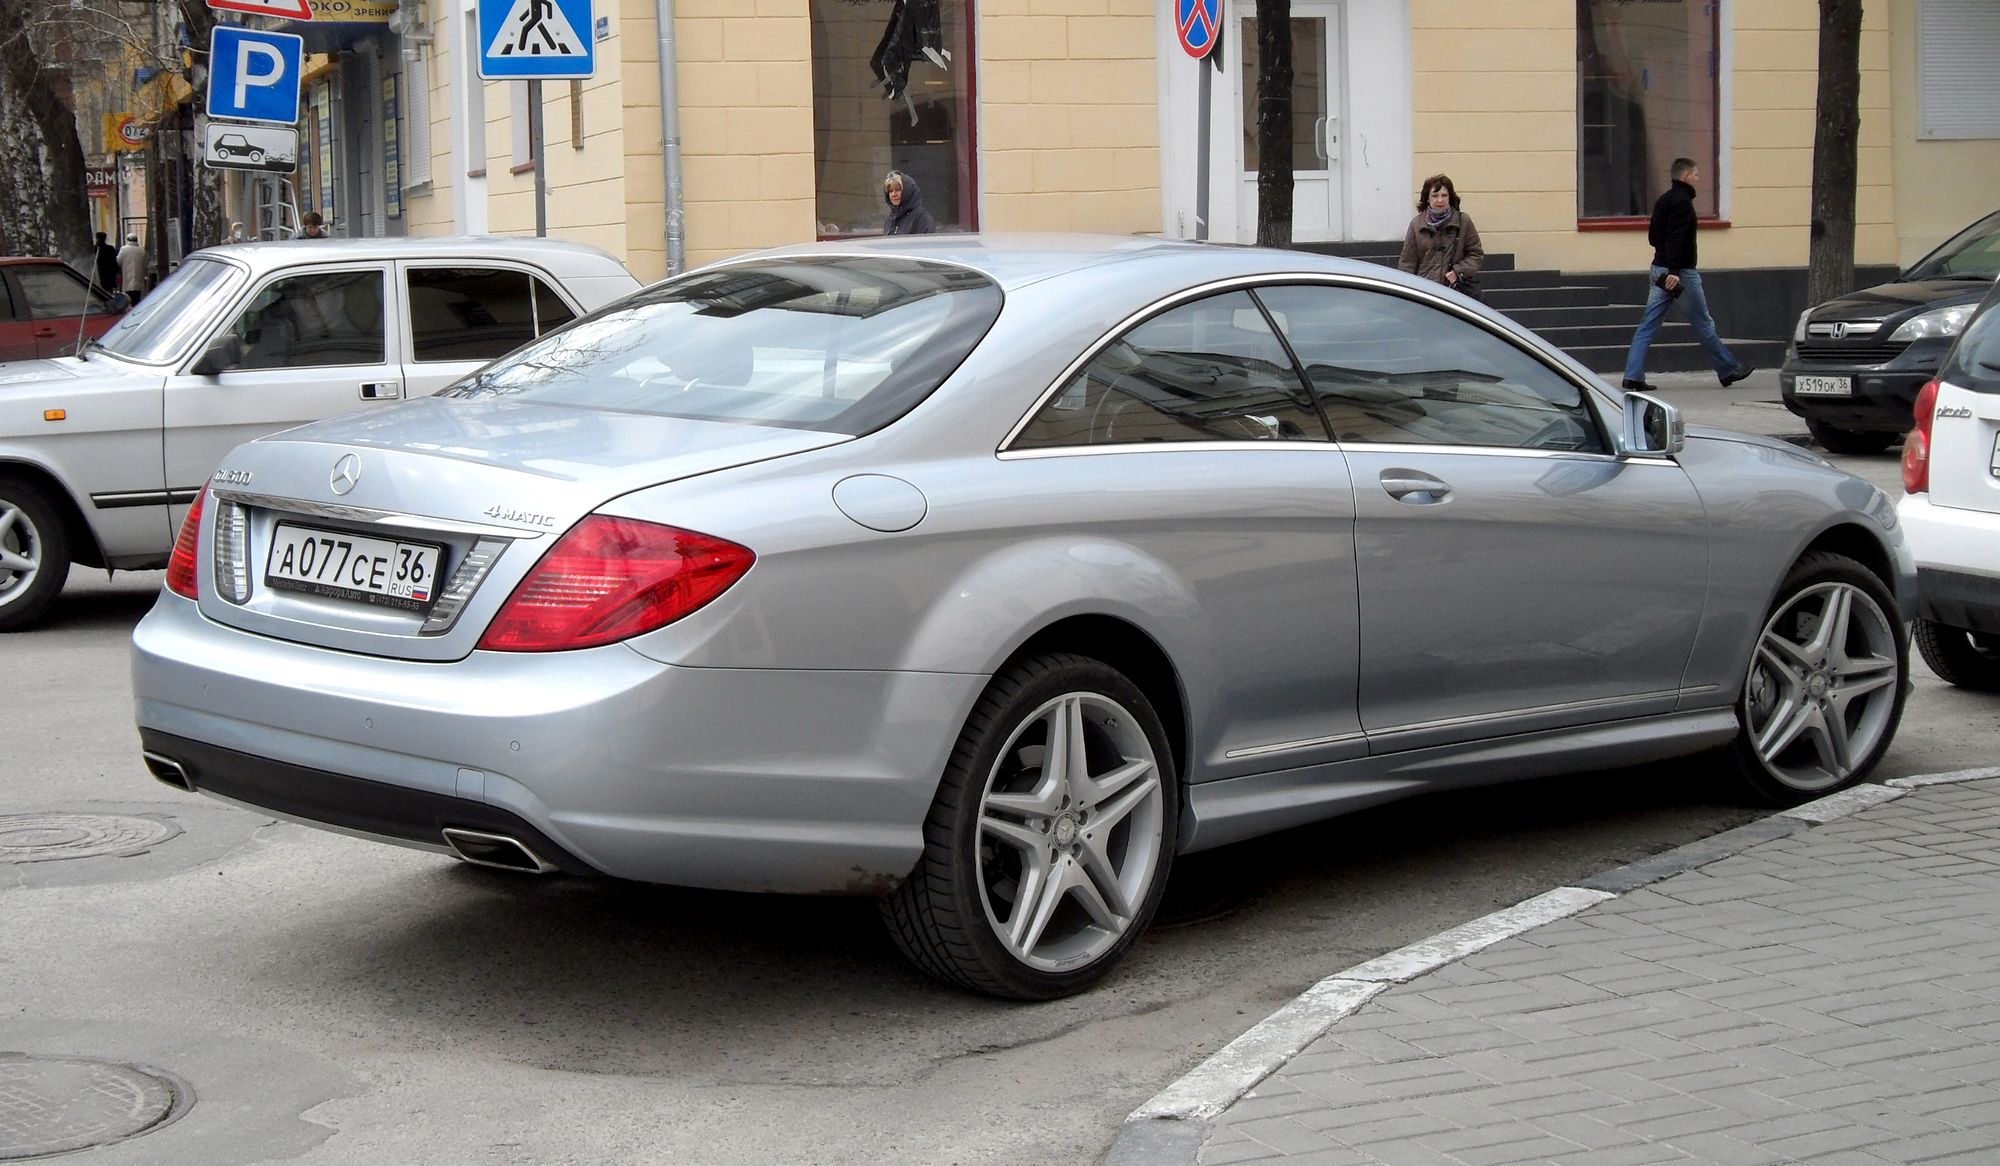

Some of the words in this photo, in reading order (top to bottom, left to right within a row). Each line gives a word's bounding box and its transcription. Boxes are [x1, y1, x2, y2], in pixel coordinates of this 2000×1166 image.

[234, 40, 285, 109] P
[484, 504, 556, 527] 4MATIC
[396, 548, 425, 583] 36
[390, 582, 412, 596] RUS
